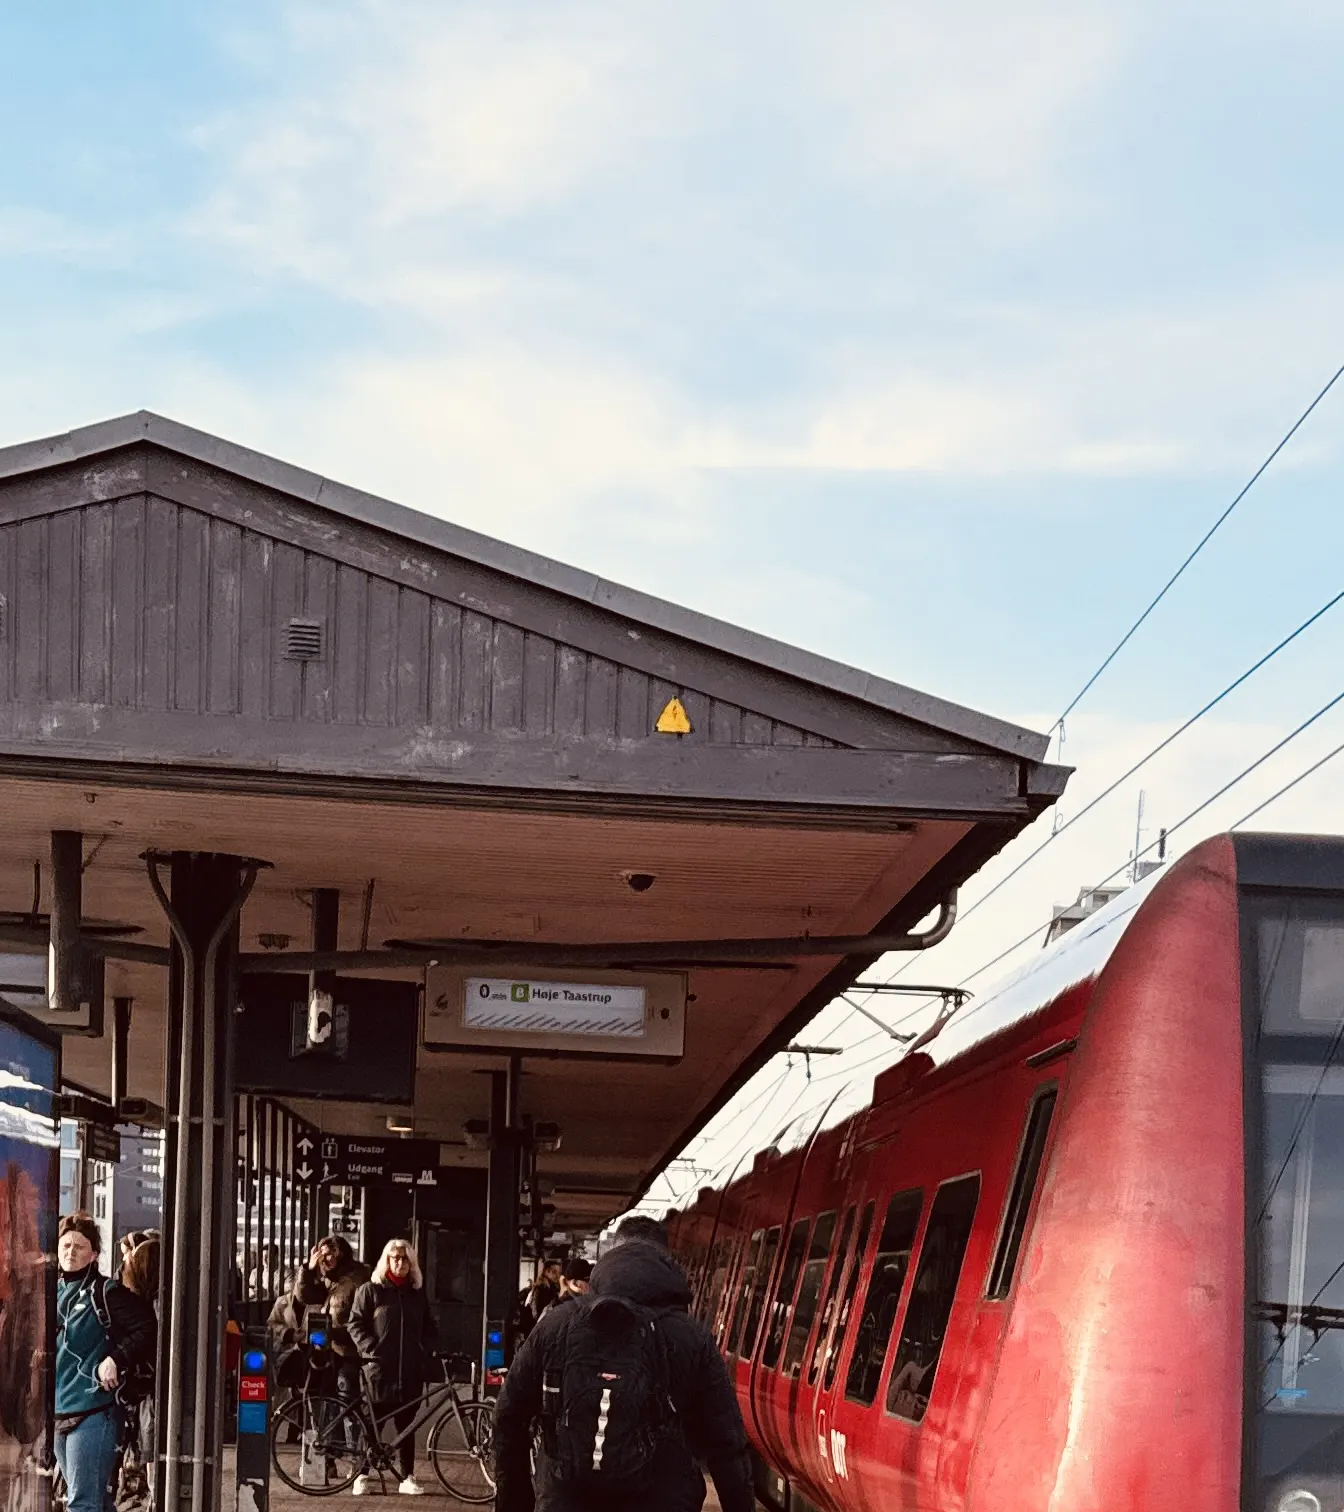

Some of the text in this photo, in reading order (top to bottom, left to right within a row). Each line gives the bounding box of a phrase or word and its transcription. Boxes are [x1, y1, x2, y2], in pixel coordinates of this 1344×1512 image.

[479, 984, 490, 998] 0
[516, 987, 525, 998] B
[532, 988, 559, 1001] Høje
[562, 990, 612, 1004] Taastrup
[348, 1143, 384, 1154] Elevator
[348, 1164, 383, 1175] Udgang
[242, 1381, 264, 1389] Check
